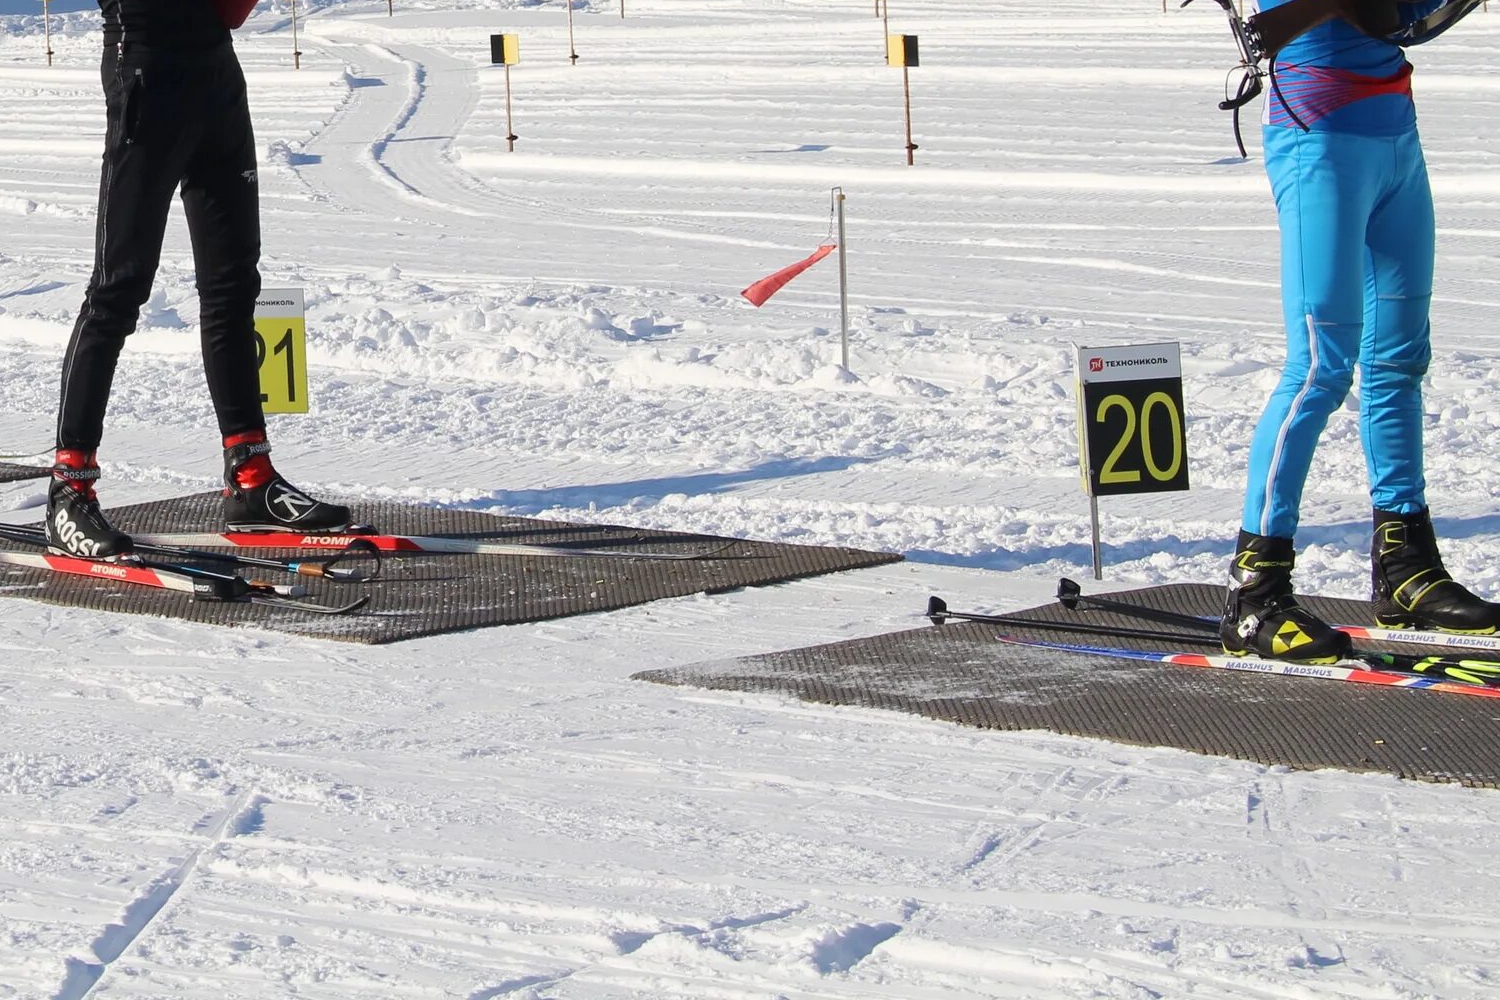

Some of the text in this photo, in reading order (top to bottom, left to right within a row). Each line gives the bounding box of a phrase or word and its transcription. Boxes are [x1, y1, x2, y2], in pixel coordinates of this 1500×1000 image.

[255, 299, 295, 307] НОНИКОЛЬ
[1105, 357, 1169, 368] ТЕХНОНИКОЛЬ
[1096, 391, 1183, 485] 20
[91, 564, 127, 578] ATOMIC
[1387, 632, 1498, 648] MADSHUS MADSHUS
[1225, 662, 1332, 677] MADSHUS MADSHUS
